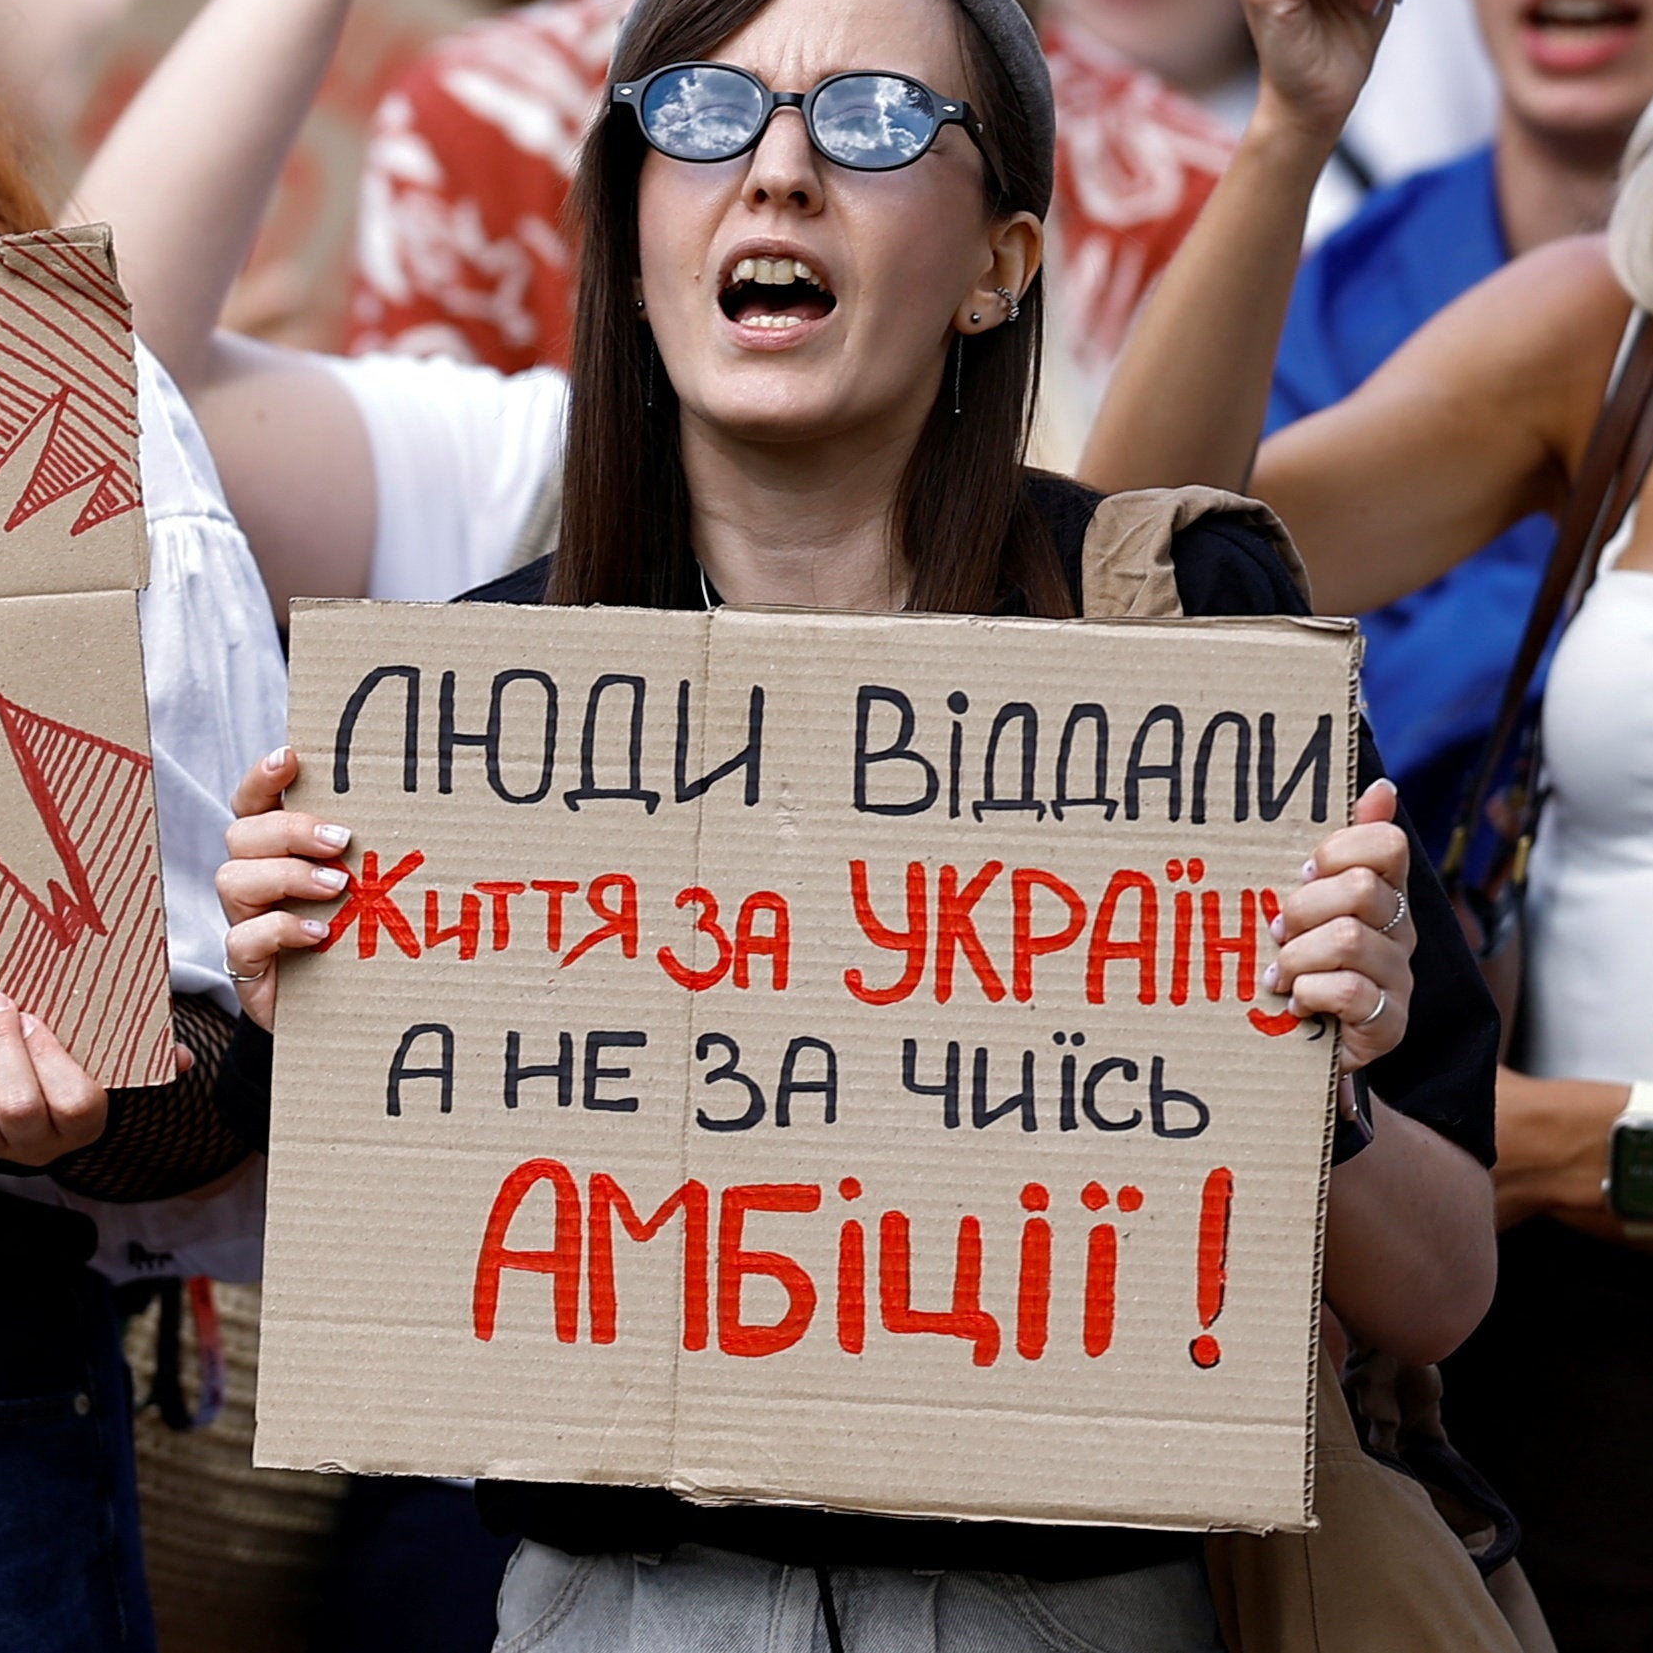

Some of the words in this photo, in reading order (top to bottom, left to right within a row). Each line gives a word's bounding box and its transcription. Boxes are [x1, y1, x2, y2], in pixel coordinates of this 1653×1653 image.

[332, 663, 766, 815] ЛЮДИ
[384, 1021, 455, 1118] А
[503, 1029, 650, 1114] НЕ
[693, 1031, 840, 1134] ЗА
[901, 1028, 1212, 1141] ЧИЇСЬ
